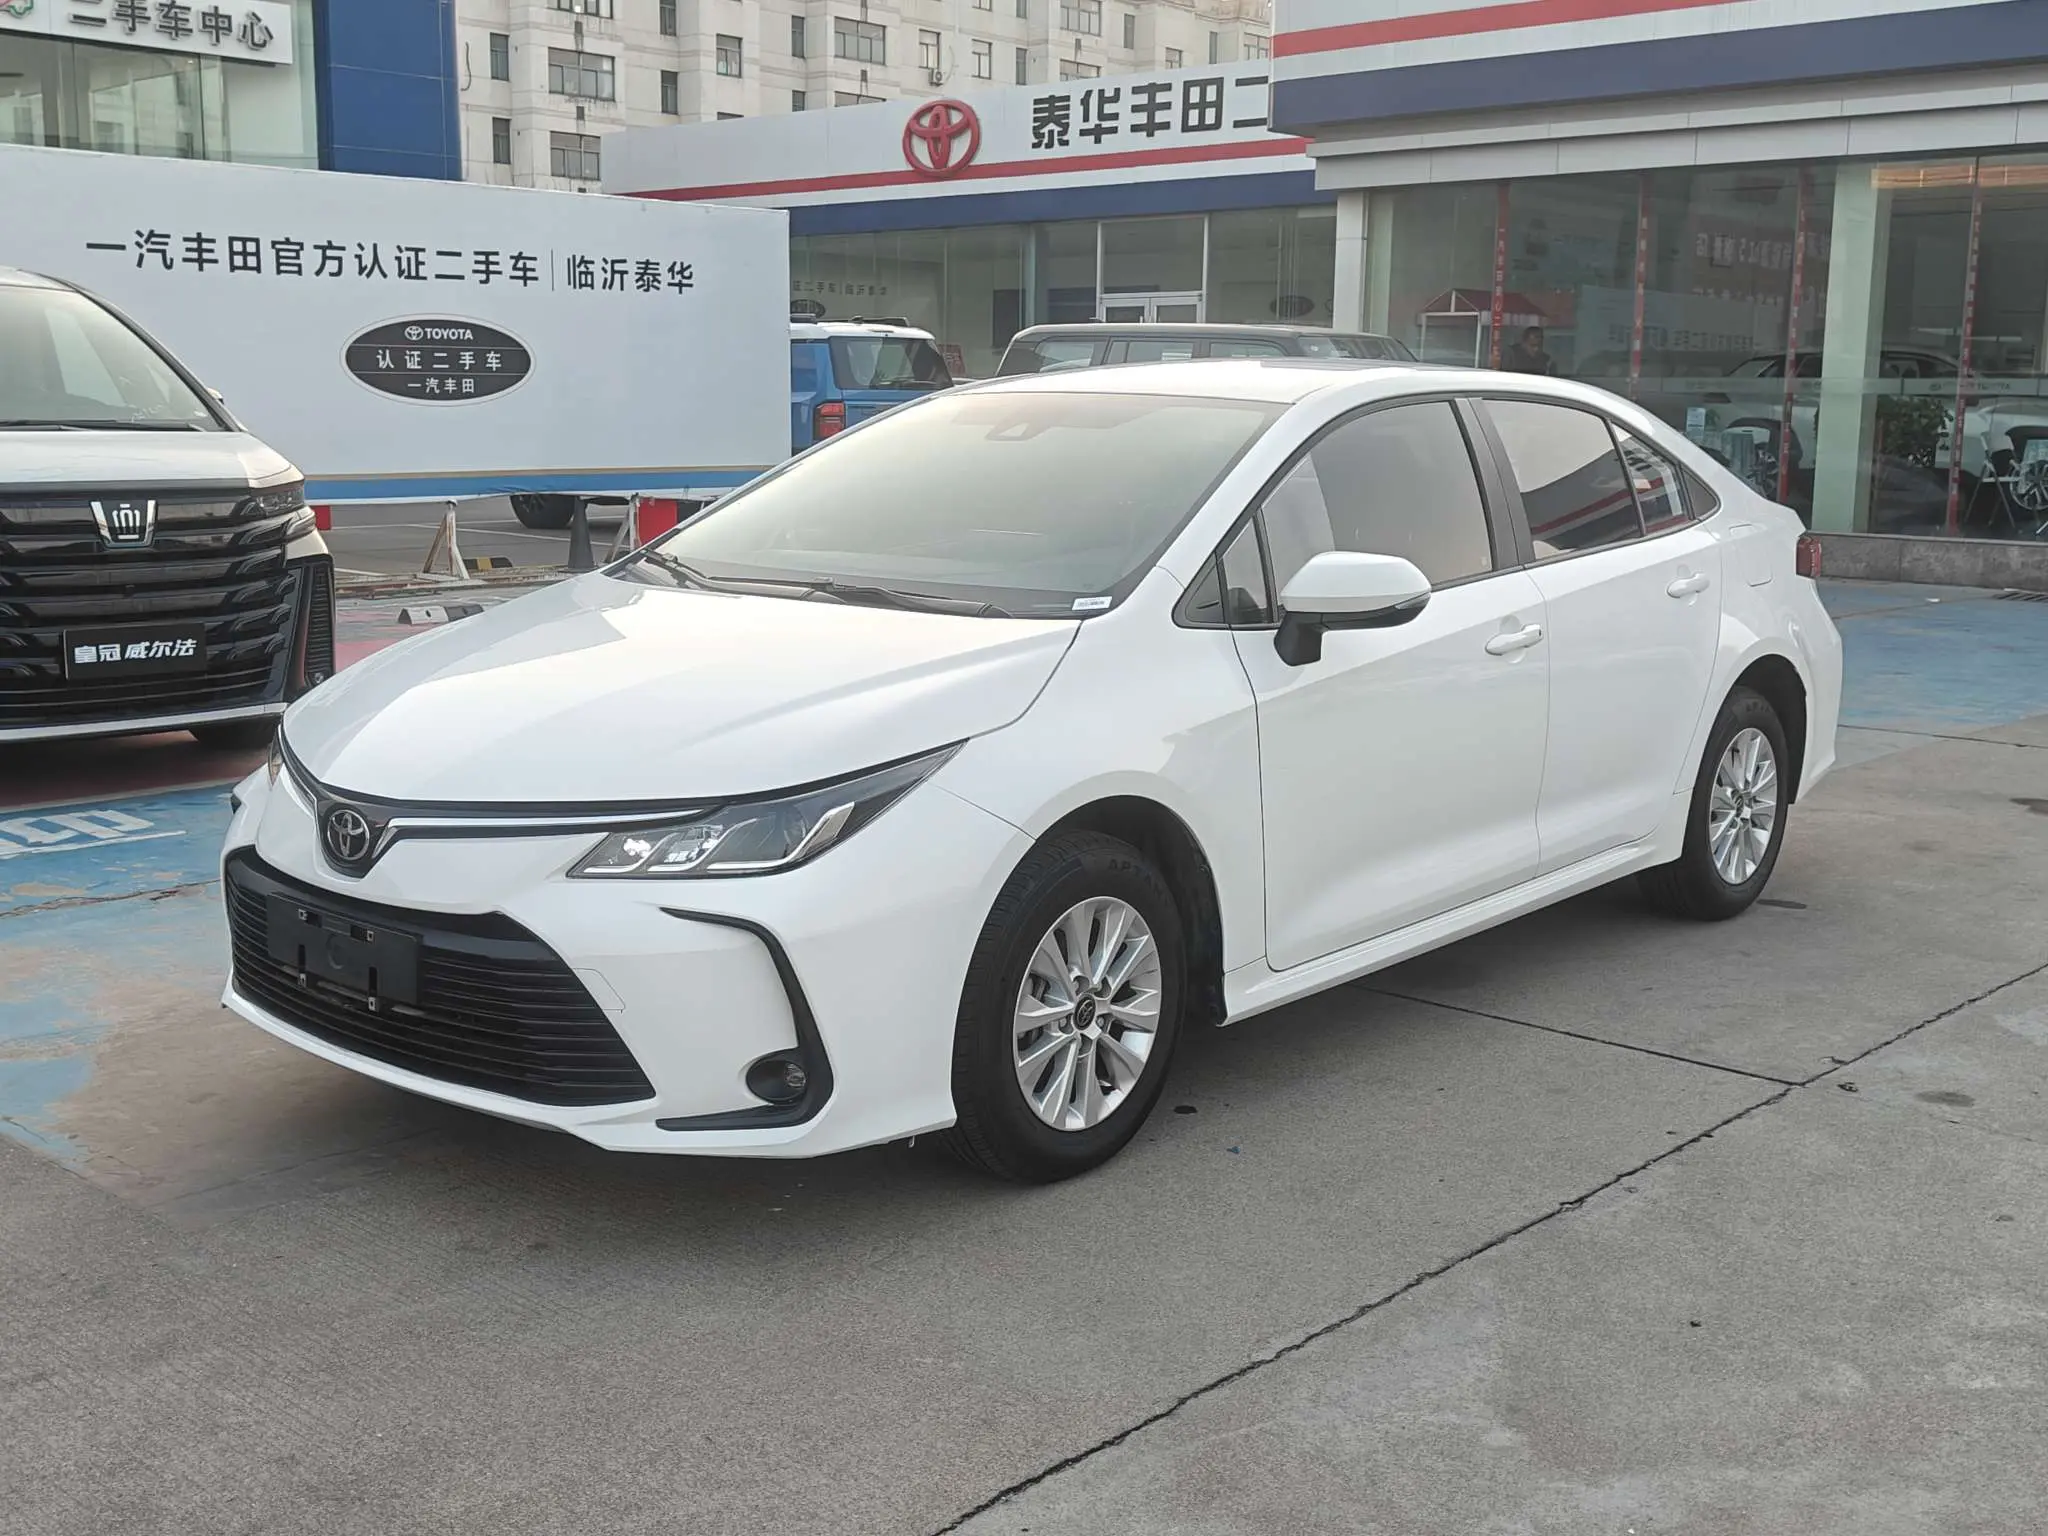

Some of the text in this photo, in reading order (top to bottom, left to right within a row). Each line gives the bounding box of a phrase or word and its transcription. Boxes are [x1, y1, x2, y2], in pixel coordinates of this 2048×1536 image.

[1031, 75, 1269, 149] 泰华丰田二
[86, 229, 694, 295] 一汽丰田官方认证二手车 临沂泰华
[424, 328, 474, 341] TOYOTA
[376, 349, 502, 372] 认证二手车
[407, 377, 475, 394] 一汽丰田
